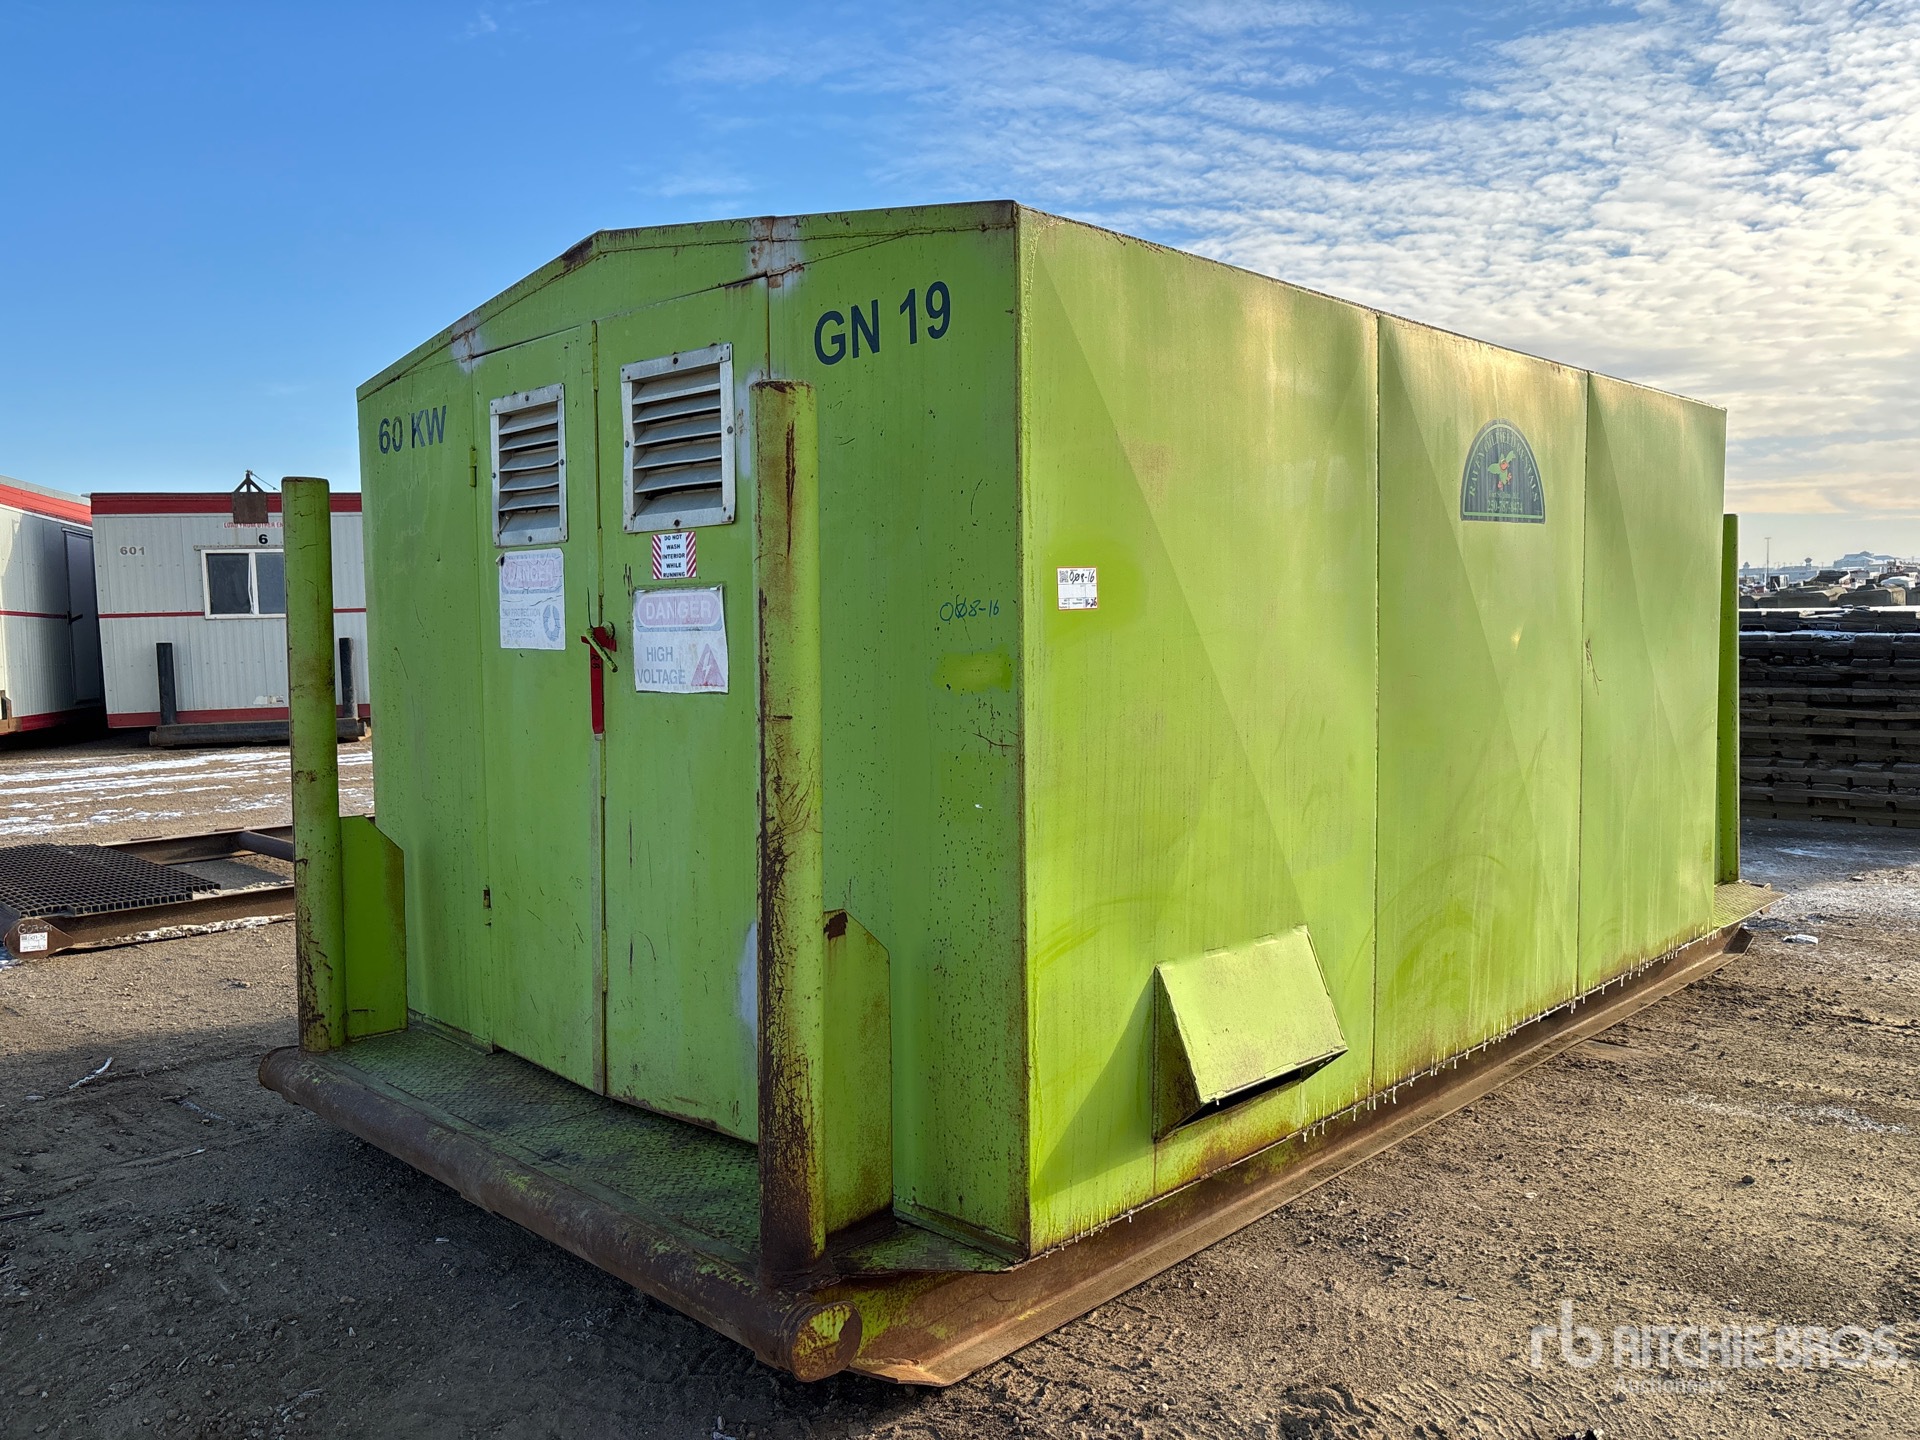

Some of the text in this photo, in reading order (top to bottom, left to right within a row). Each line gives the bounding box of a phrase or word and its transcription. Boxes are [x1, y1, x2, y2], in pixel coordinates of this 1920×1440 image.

[813, 280, 951, 366] GN 19
[378, 404, 447, 455] 60 KW
[1484, 431, 1518, 453] OILFIELD
[258, 533, 269, 545] 6
[119, 546, 145, 556] 601
[662, 552, 685, 560] INTERIOR
[645, 599, 712, 620] DANGER
[646, 646, 674, 662] HIGH
[637, 668, 687, 685] VOLTAGE
